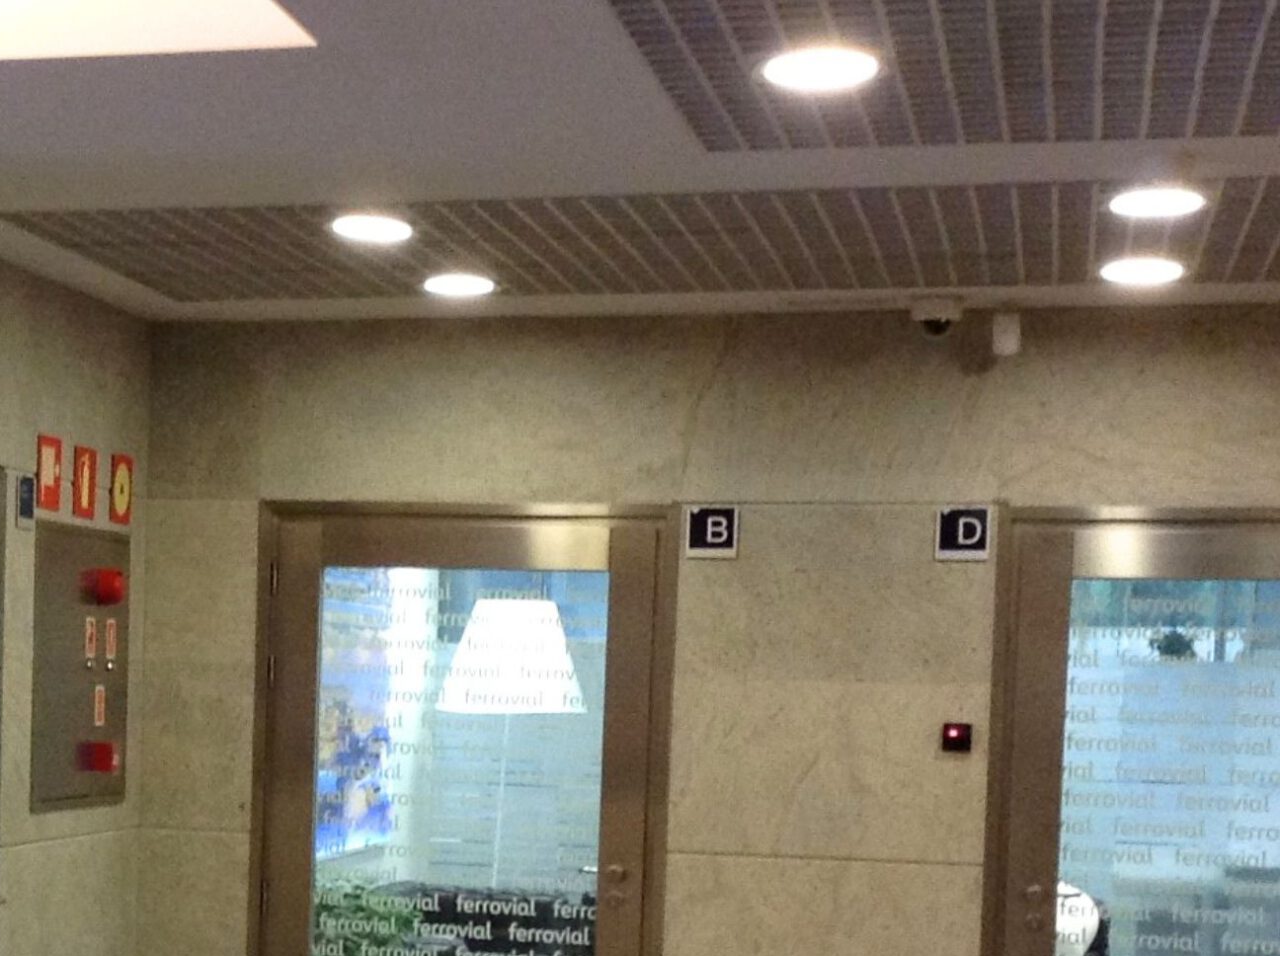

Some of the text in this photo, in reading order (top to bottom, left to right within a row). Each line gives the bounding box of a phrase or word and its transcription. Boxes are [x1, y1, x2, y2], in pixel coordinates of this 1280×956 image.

[706, 516, 728, 543] B
[957, 517, 982, 545] D
[520, 663, 577, 683] ferrov
[456, 894, 536, 917] ferrovial
[320, 912, 590, 946] ferrovial ferrovial ferrovial
